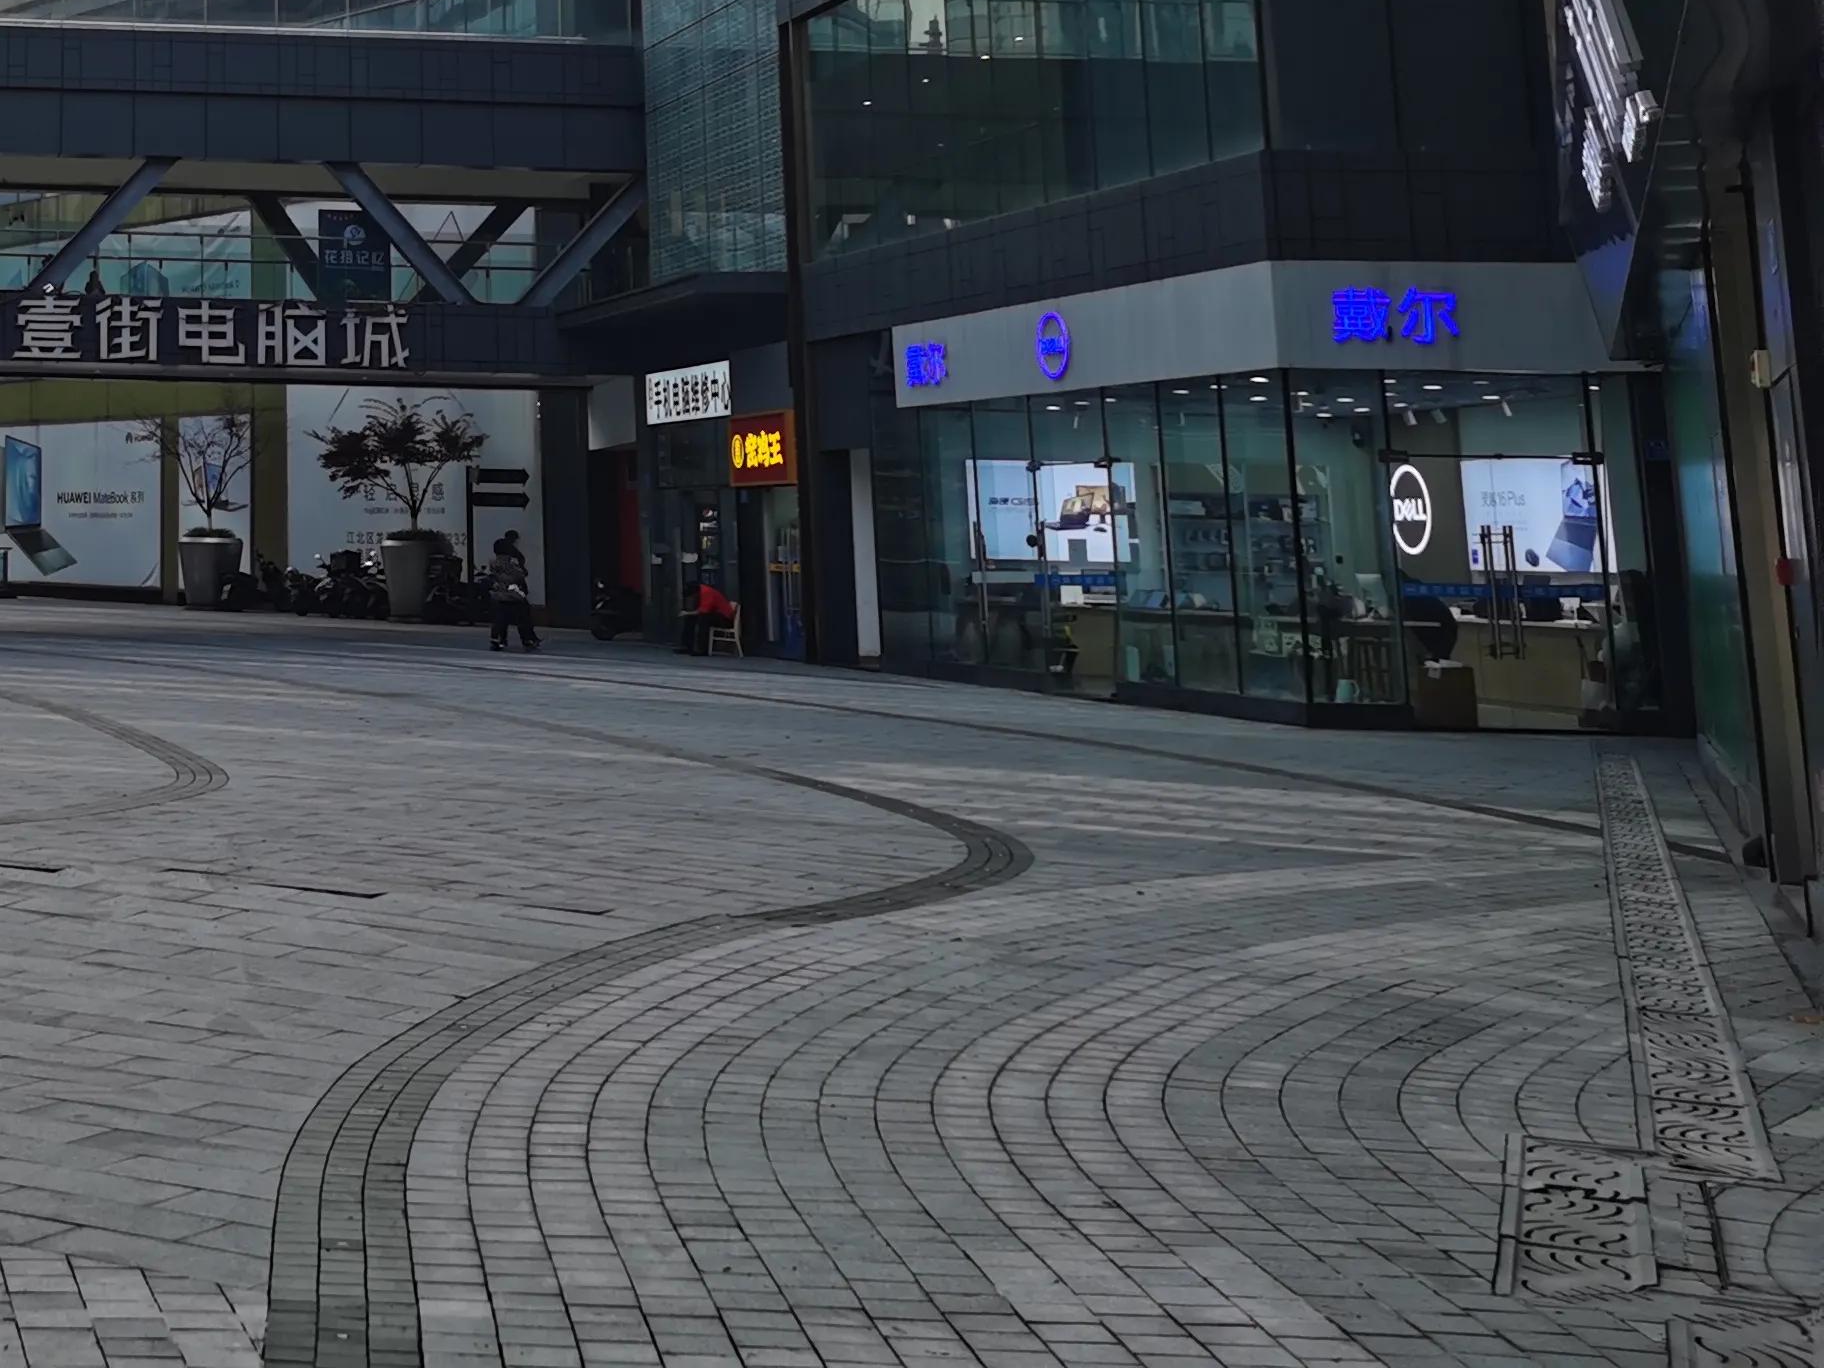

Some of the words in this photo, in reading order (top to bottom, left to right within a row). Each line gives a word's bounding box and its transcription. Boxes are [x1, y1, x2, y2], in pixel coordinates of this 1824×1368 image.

[1332, 285, 1461, 344] 戴尔
[57, 492, 91, 504] HUAWEI
[93, 492, 129, 504] MateBook
[1392, 498, 1427, 521] DELL
